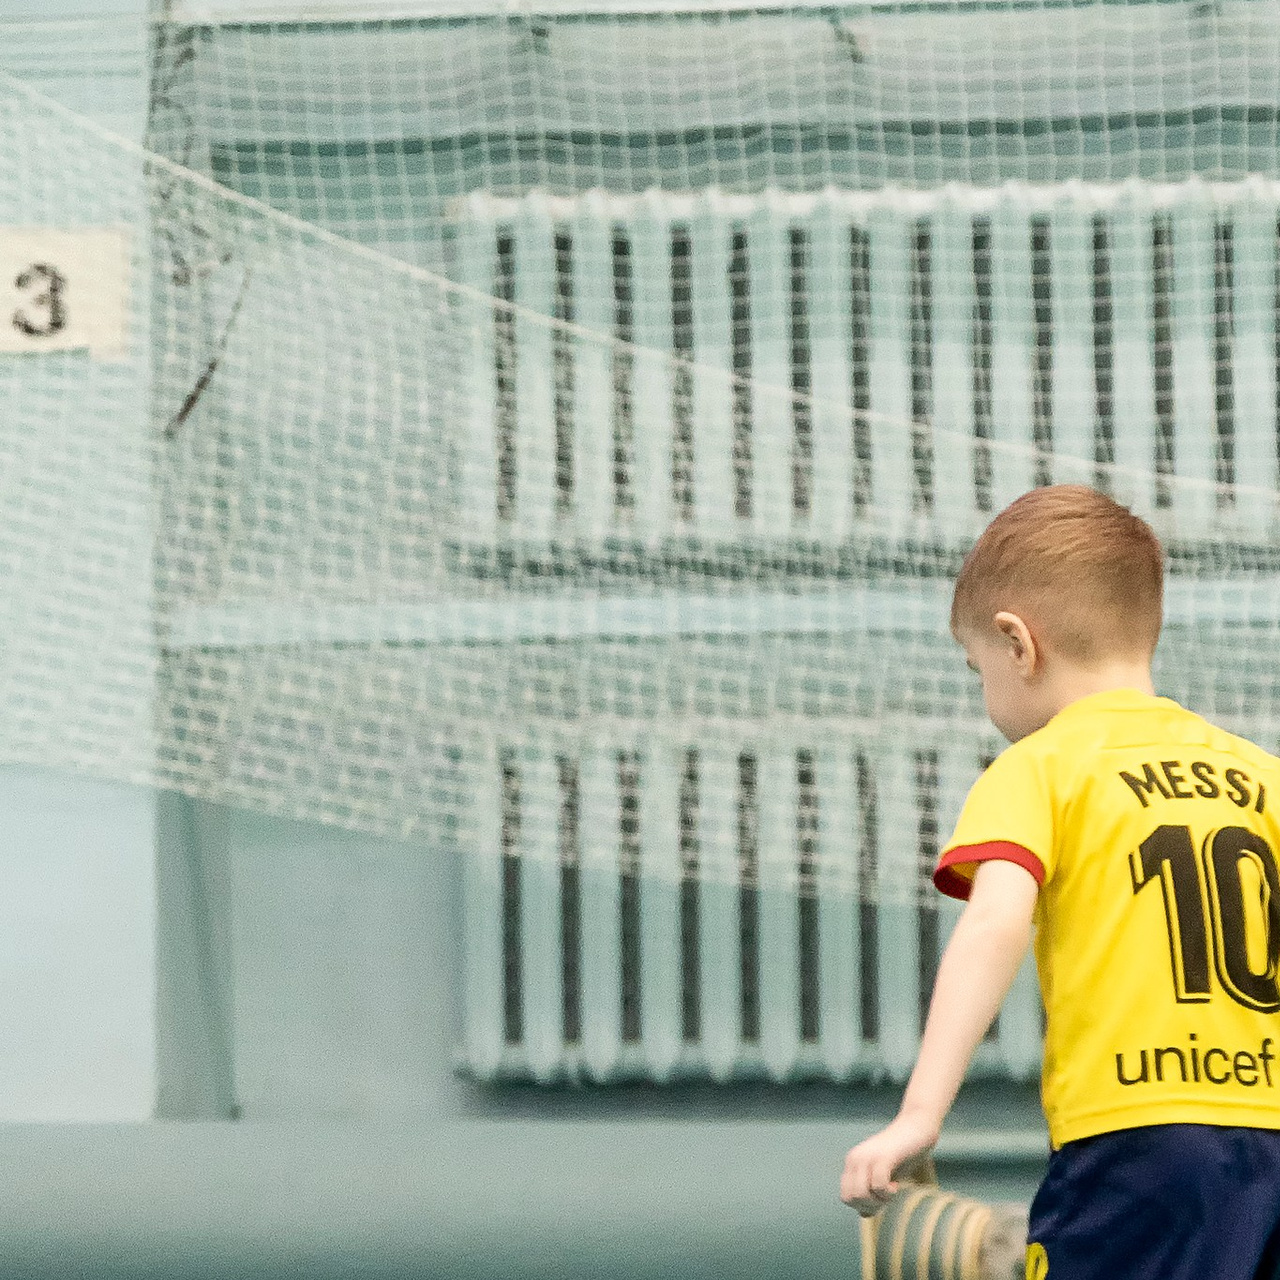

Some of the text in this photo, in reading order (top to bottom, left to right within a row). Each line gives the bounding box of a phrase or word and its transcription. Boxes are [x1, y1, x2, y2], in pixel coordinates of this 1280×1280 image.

[12, 262, 67, 337] 3
[1118, 760, 1266, 814] MESSI
[1115, 1032, 1276, 1088] unicef
